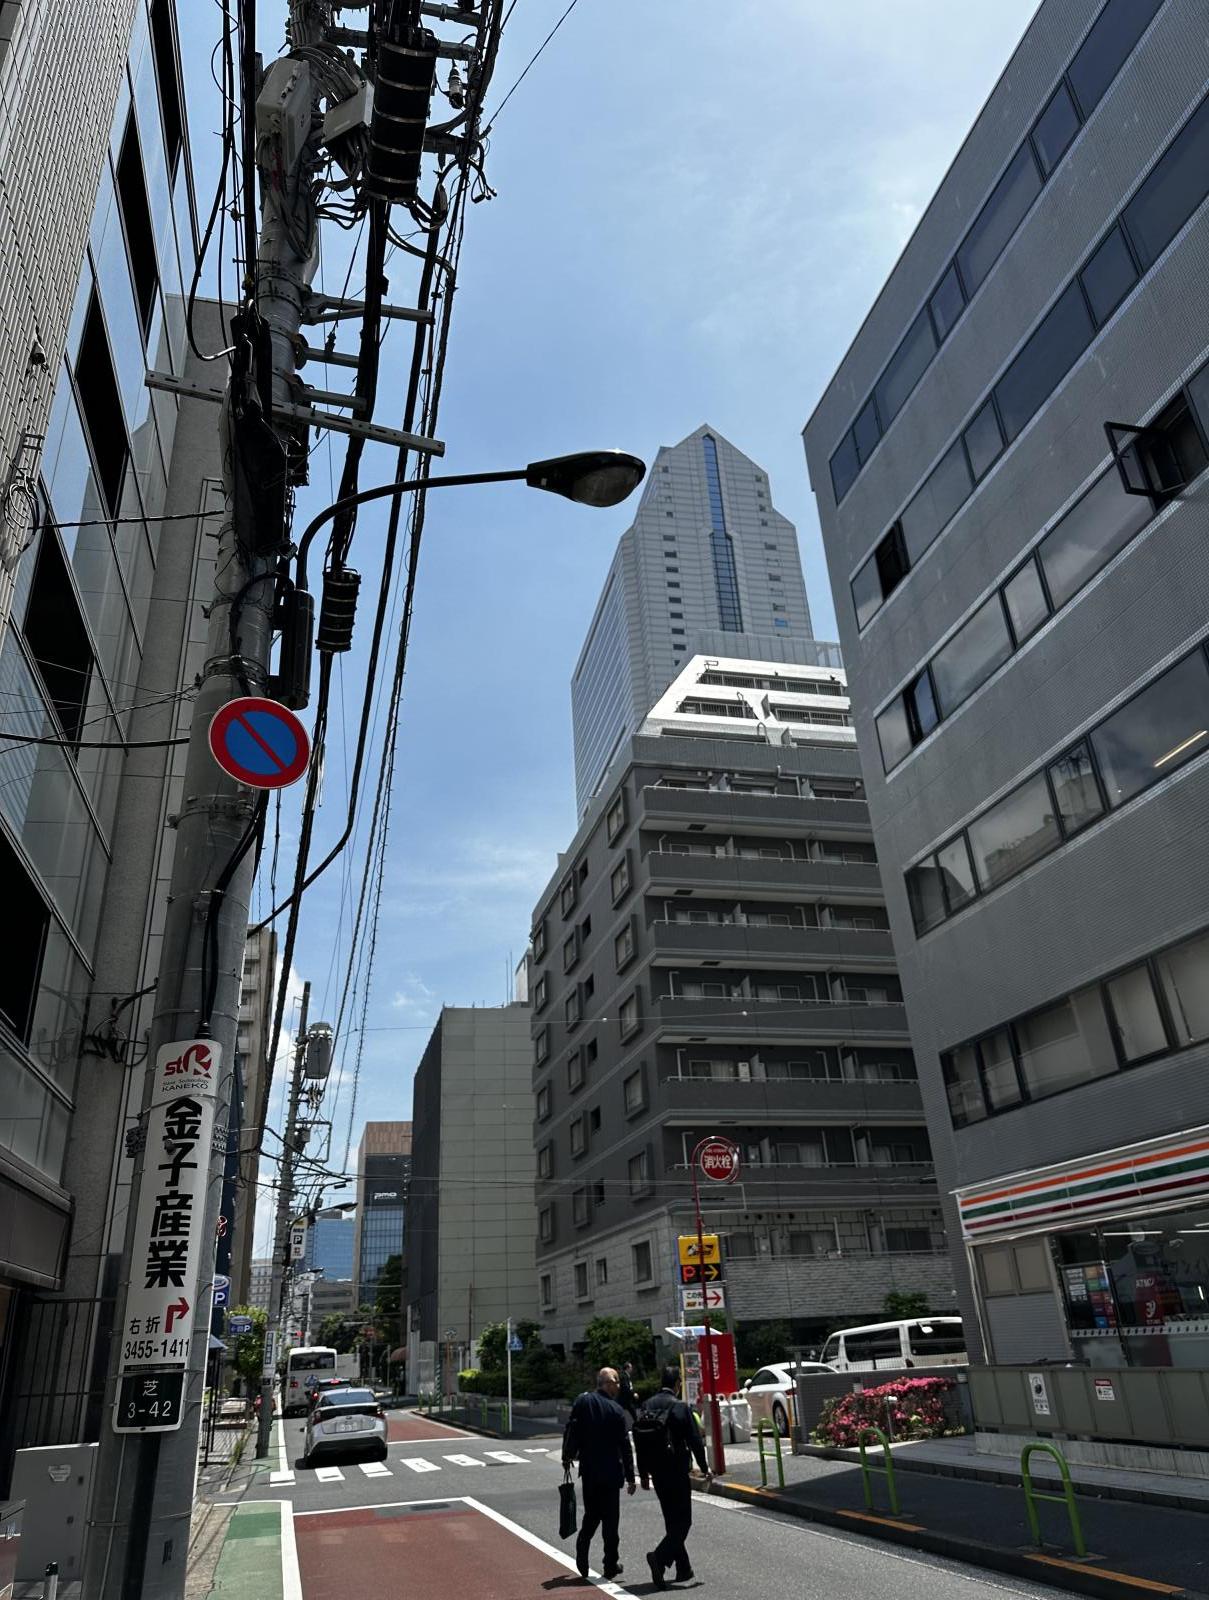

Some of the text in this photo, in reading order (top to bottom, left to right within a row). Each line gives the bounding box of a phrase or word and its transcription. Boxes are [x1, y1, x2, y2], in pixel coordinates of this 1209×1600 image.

[162, 1082, 209, 1092] KANEKO
[704, 1154, 732, 1169] 消火栓
[144, 1097, 203, 1288] 金子産業
[214, 1292, 226, 1305] P
[129, 1316, 161, 1335] 右折
[124, 1338, 190, 1360] 3455-1411
[142, 1379, 159, 1396] 芝
[127, 1400, 172, 1418] 3-42
